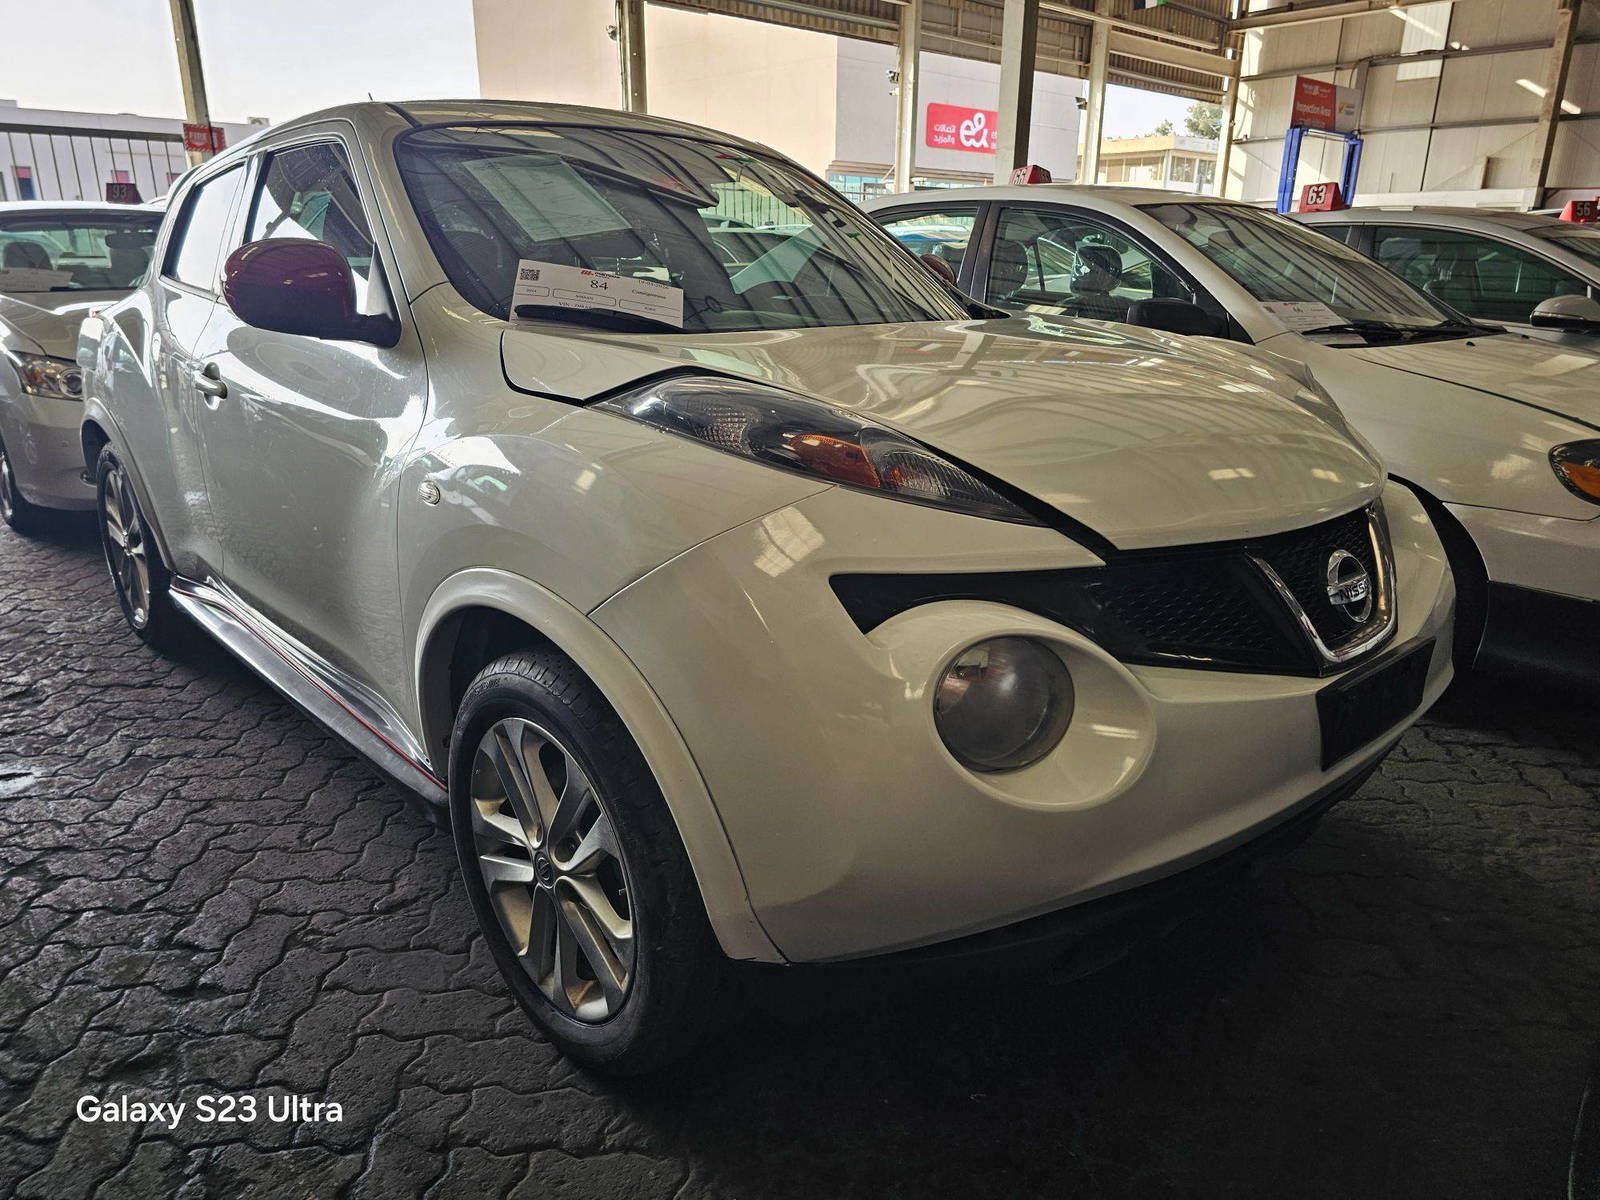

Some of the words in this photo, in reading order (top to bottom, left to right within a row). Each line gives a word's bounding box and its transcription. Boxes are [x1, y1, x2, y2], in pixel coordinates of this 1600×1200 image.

[112, 185, 128, 199] 93
[1307, 185, 1327, 205] 63
[1576, 201, 1591, 217] 56
[590, 279, 609, 291] 84
